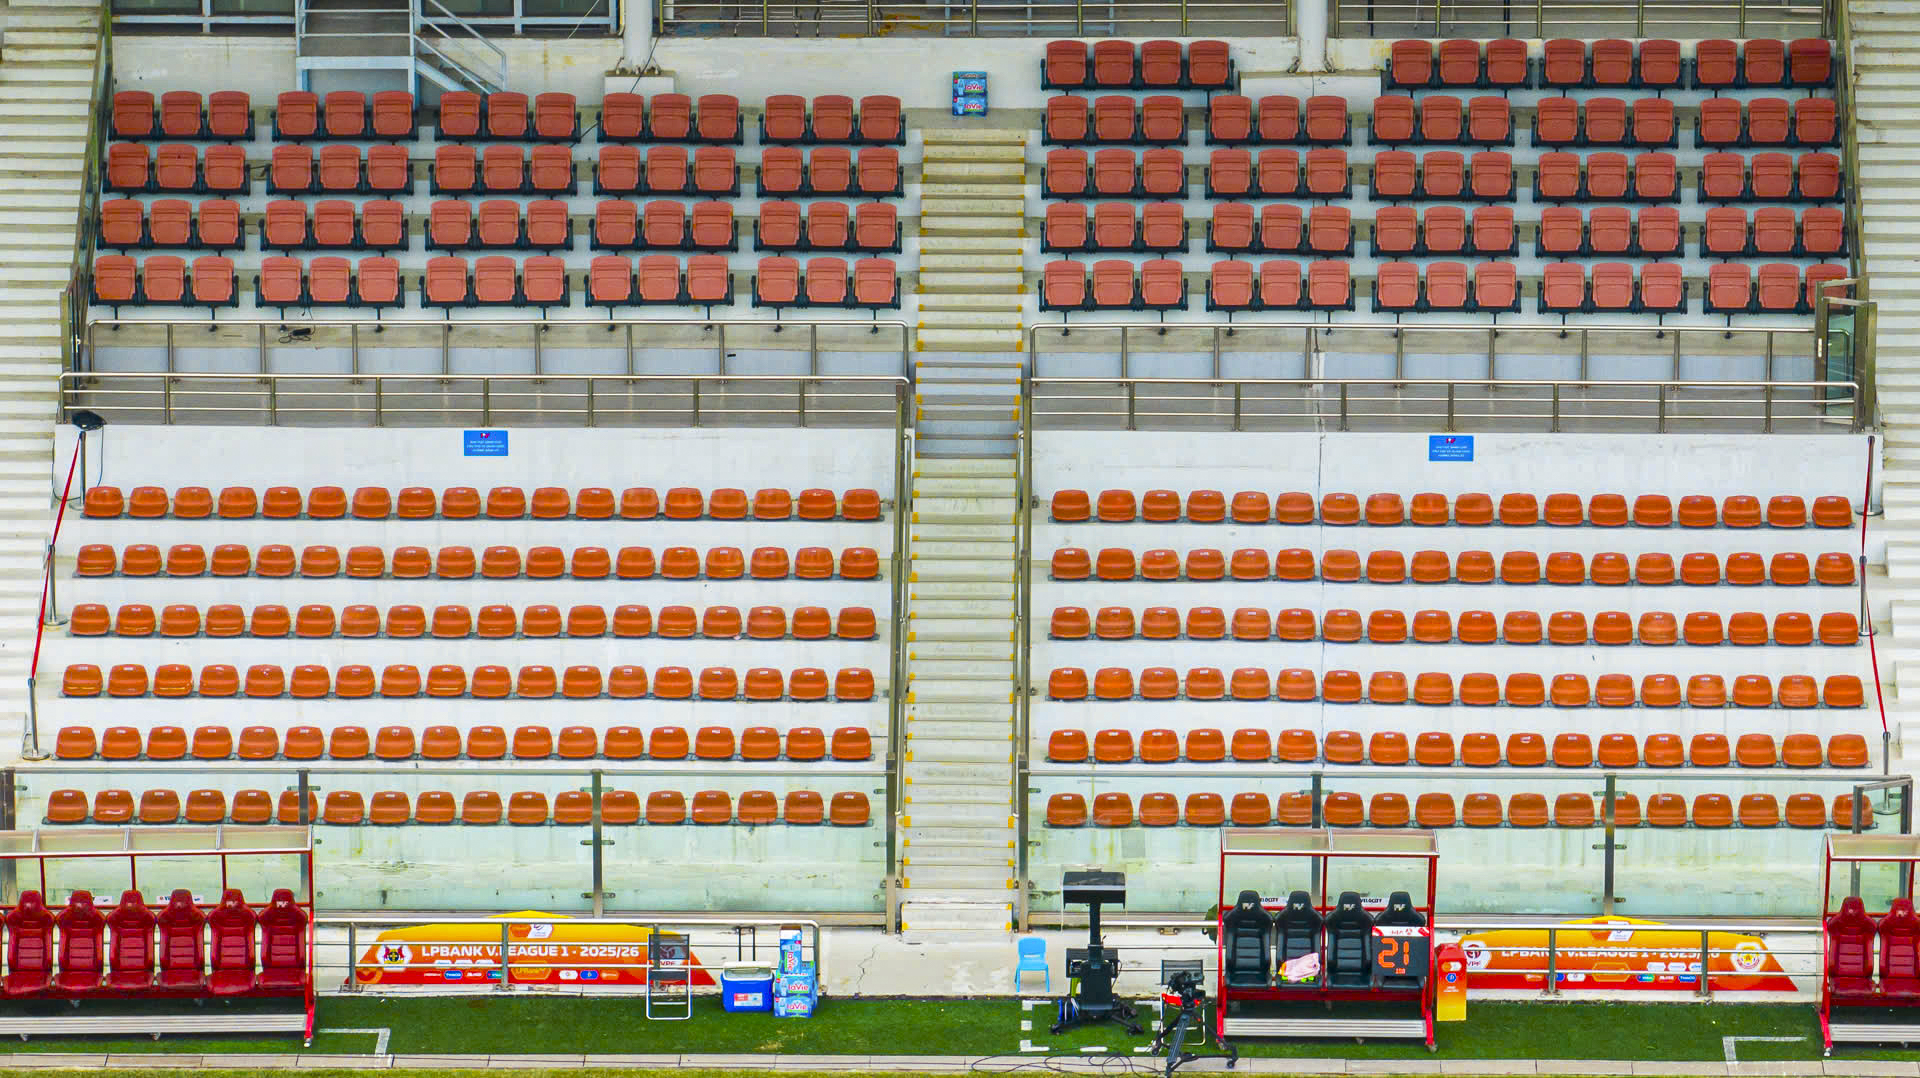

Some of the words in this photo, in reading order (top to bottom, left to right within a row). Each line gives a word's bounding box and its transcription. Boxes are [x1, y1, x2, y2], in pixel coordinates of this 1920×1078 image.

[421, 945, 483, 957] LPBANK
[560, 945, 569, 957] 1
[579, 945, 640, 958] 2025/26
[1377, 937, 1410, 968] 21
[1660, 947, 1720, 959] 2025/6
